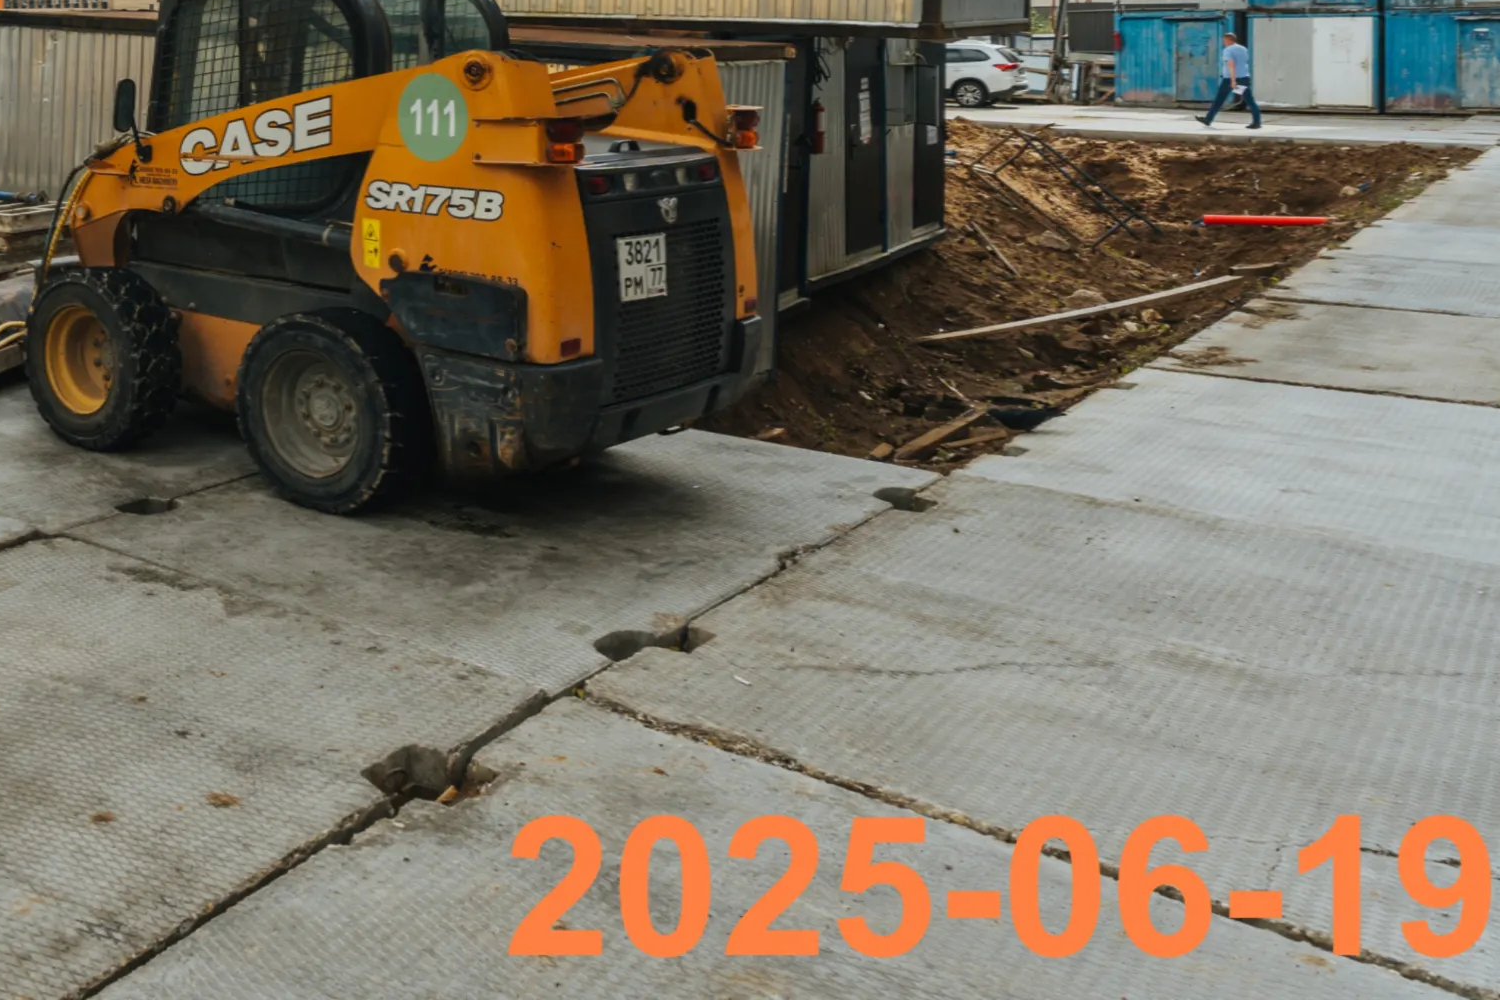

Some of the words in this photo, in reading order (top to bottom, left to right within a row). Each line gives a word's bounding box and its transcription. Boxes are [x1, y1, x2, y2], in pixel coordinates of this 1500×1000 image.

[410, 98, 457, 138] 111
[180, 95, 332, 176] CASE
[365, 179, 504, 222] SR175B
[624, 238, 660, 266] 3821
[624, 275, 644, 297] РМ
[650, 267, 663, 287] 77
